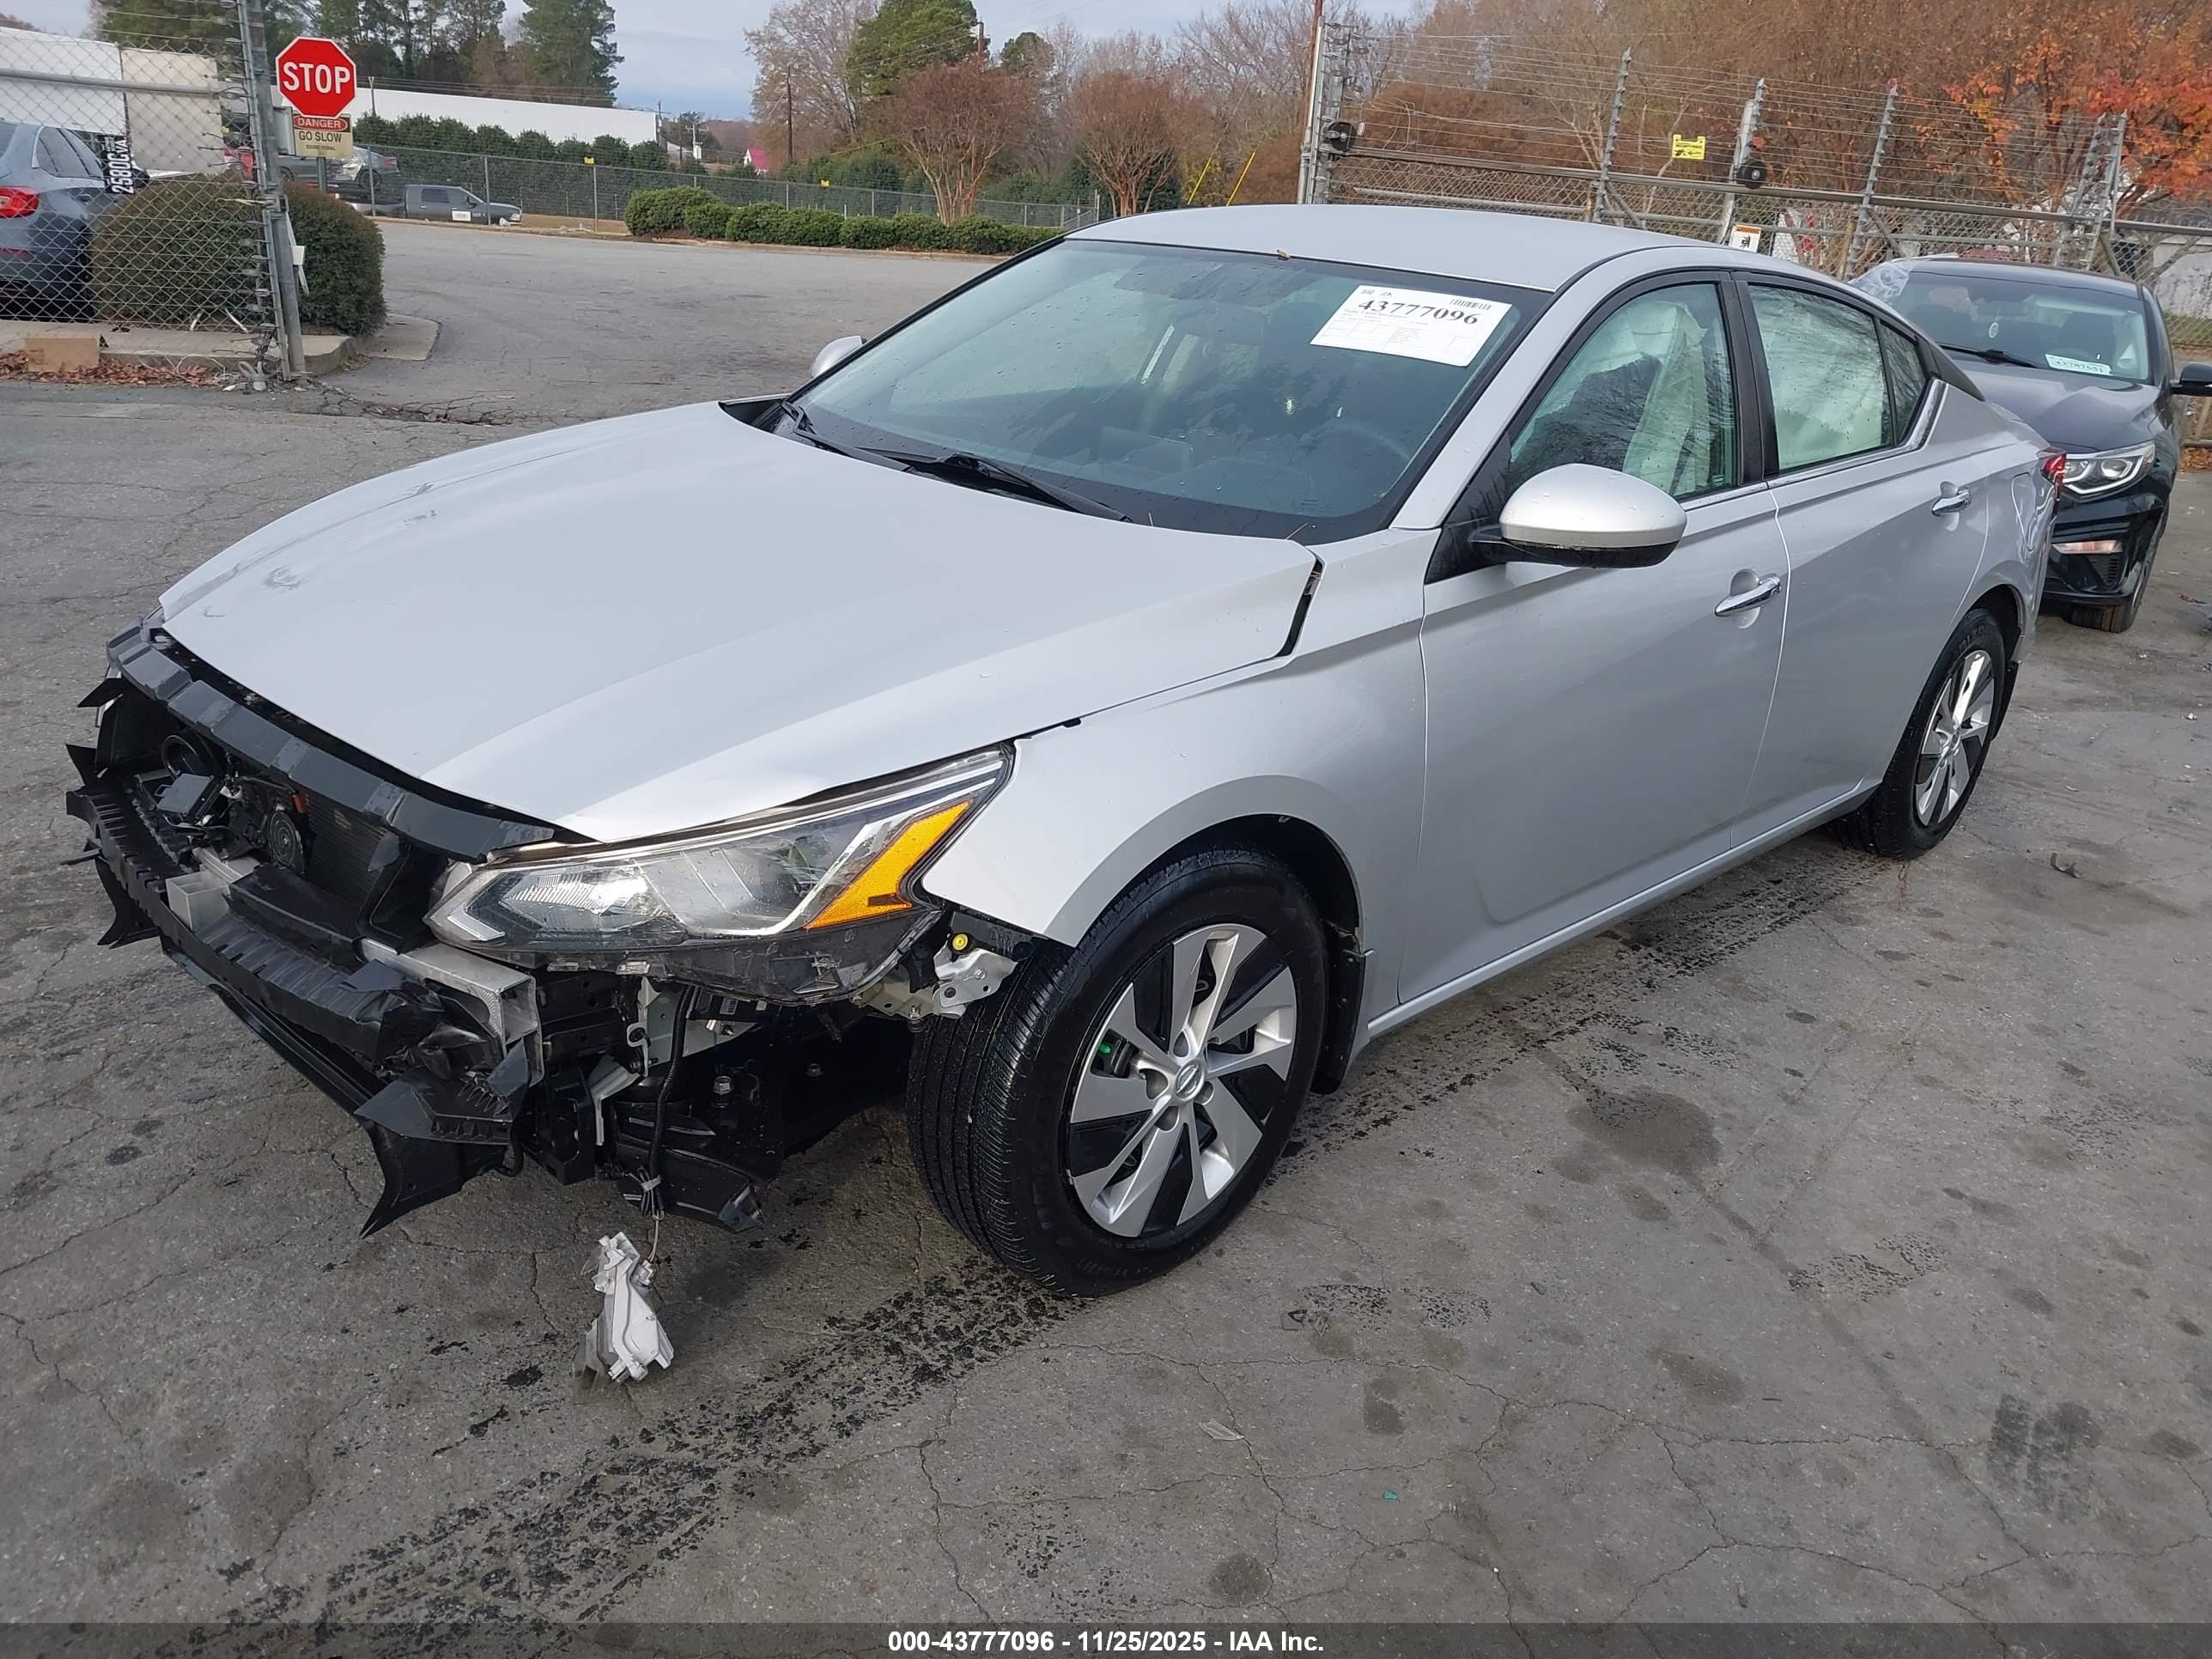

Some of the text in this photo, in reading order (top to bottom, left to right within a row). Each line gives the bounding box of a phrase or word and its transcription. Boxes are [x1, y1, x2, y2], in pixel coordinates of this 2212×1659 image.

[283, 62, 350, 94] STOP
[297, 118, 342, 129] DANGER
[298, 131, 343, 143] GO SLOW
[1358, 300, 1482, 325] 43777096
